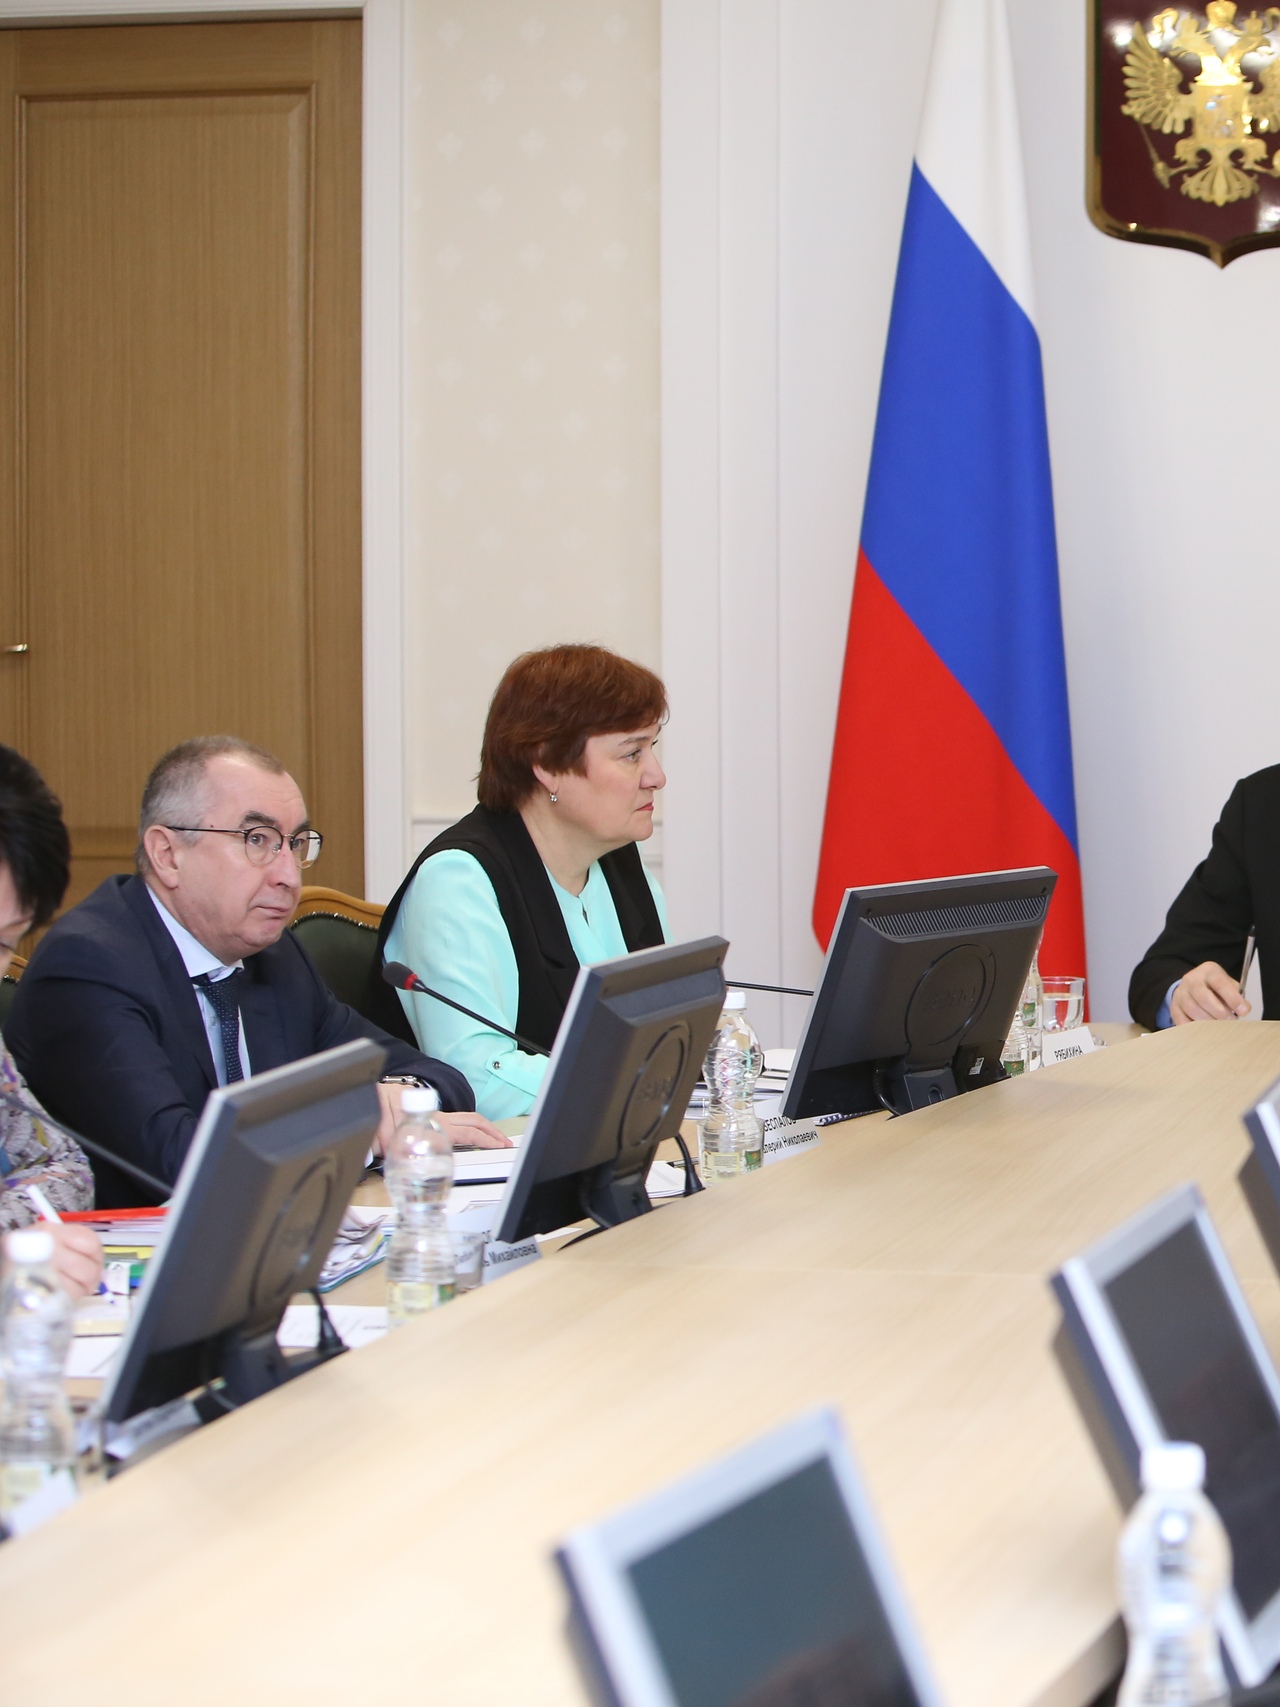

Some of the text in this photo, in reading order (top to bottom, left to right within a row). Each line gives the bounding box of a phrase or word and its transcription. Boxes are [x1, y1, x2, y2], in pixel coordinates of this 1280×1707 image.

[763, 1130, 819, 1153] лерий Николаевич
[488, 1243, 538, 1265] Михайловна
